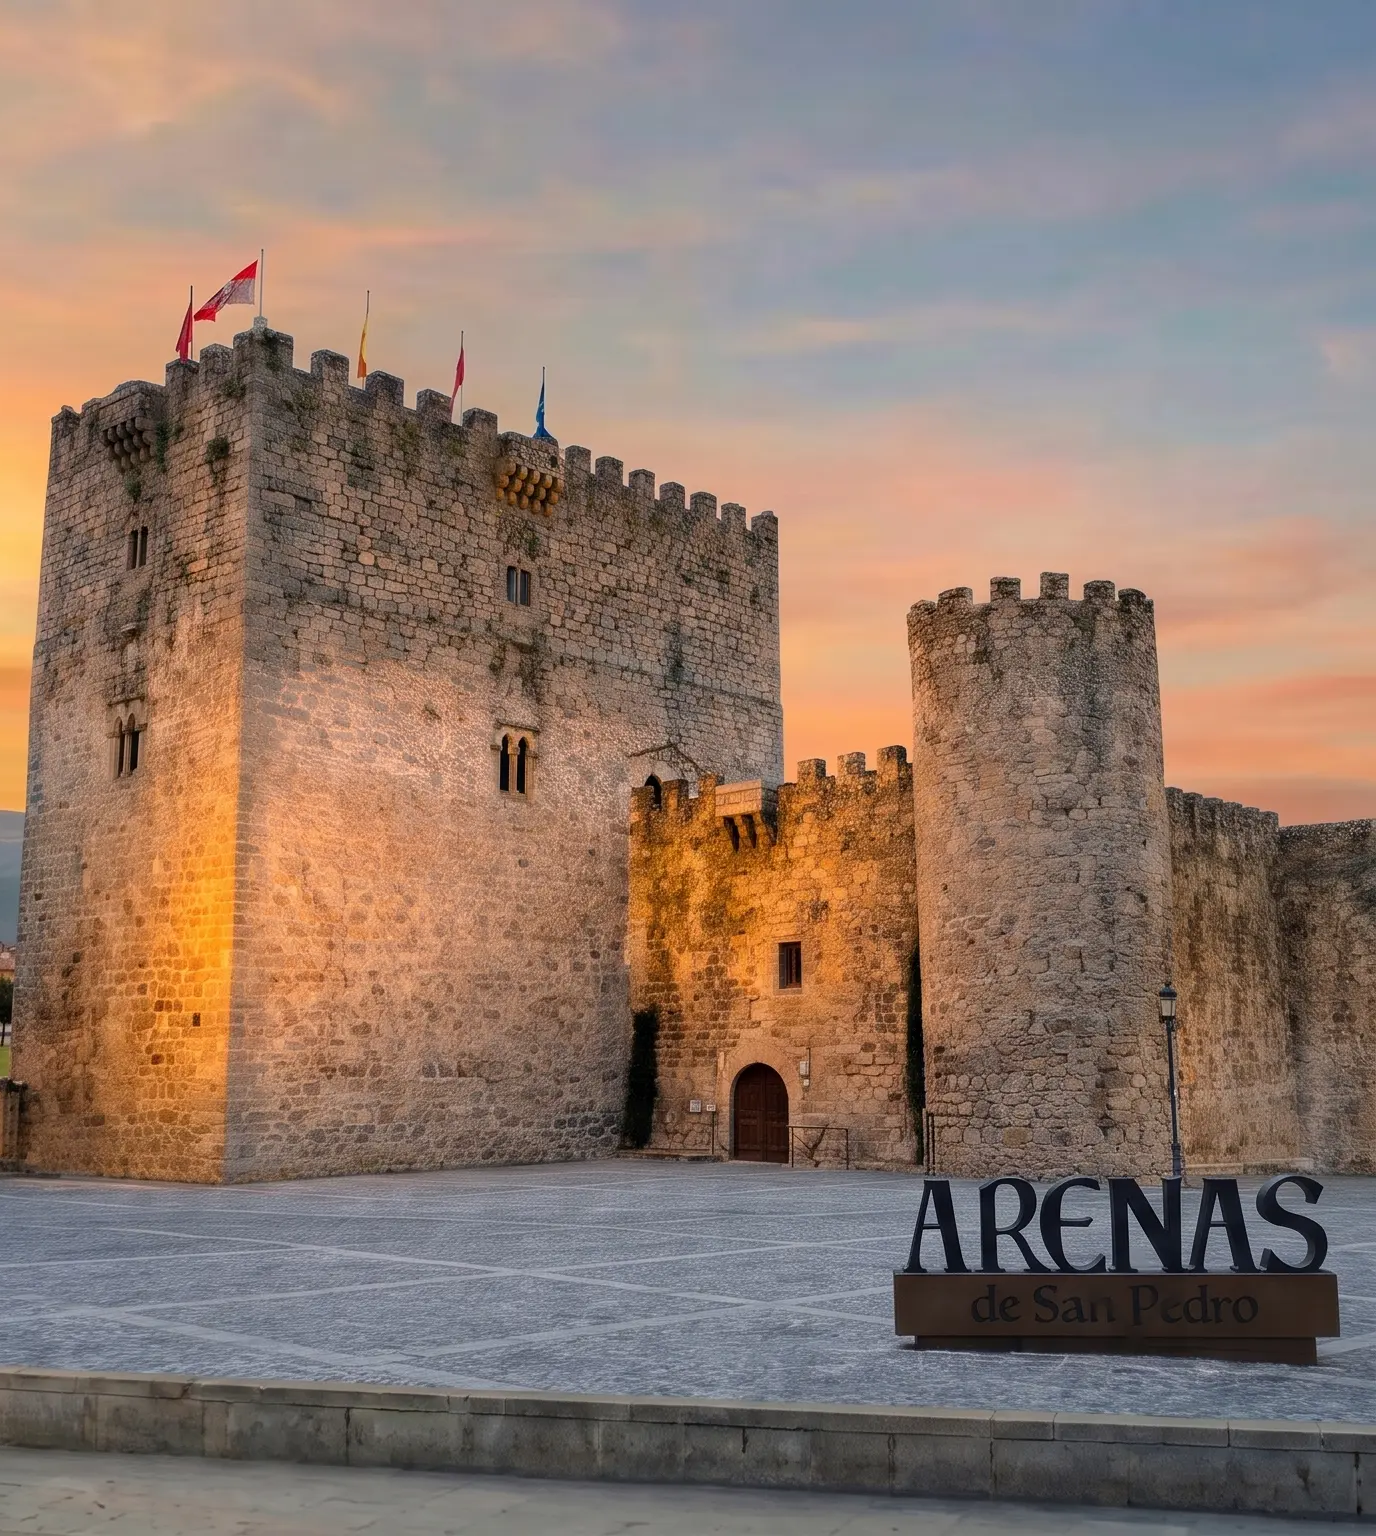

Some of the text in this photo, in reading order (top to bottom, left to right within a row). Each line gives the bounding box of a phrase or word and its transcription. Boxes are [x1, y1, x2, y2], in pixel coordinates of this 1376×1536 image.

[903, 1174, 1328, 1274] ARENAS
[971, 1284, 1259, 1327] de San Pedro
